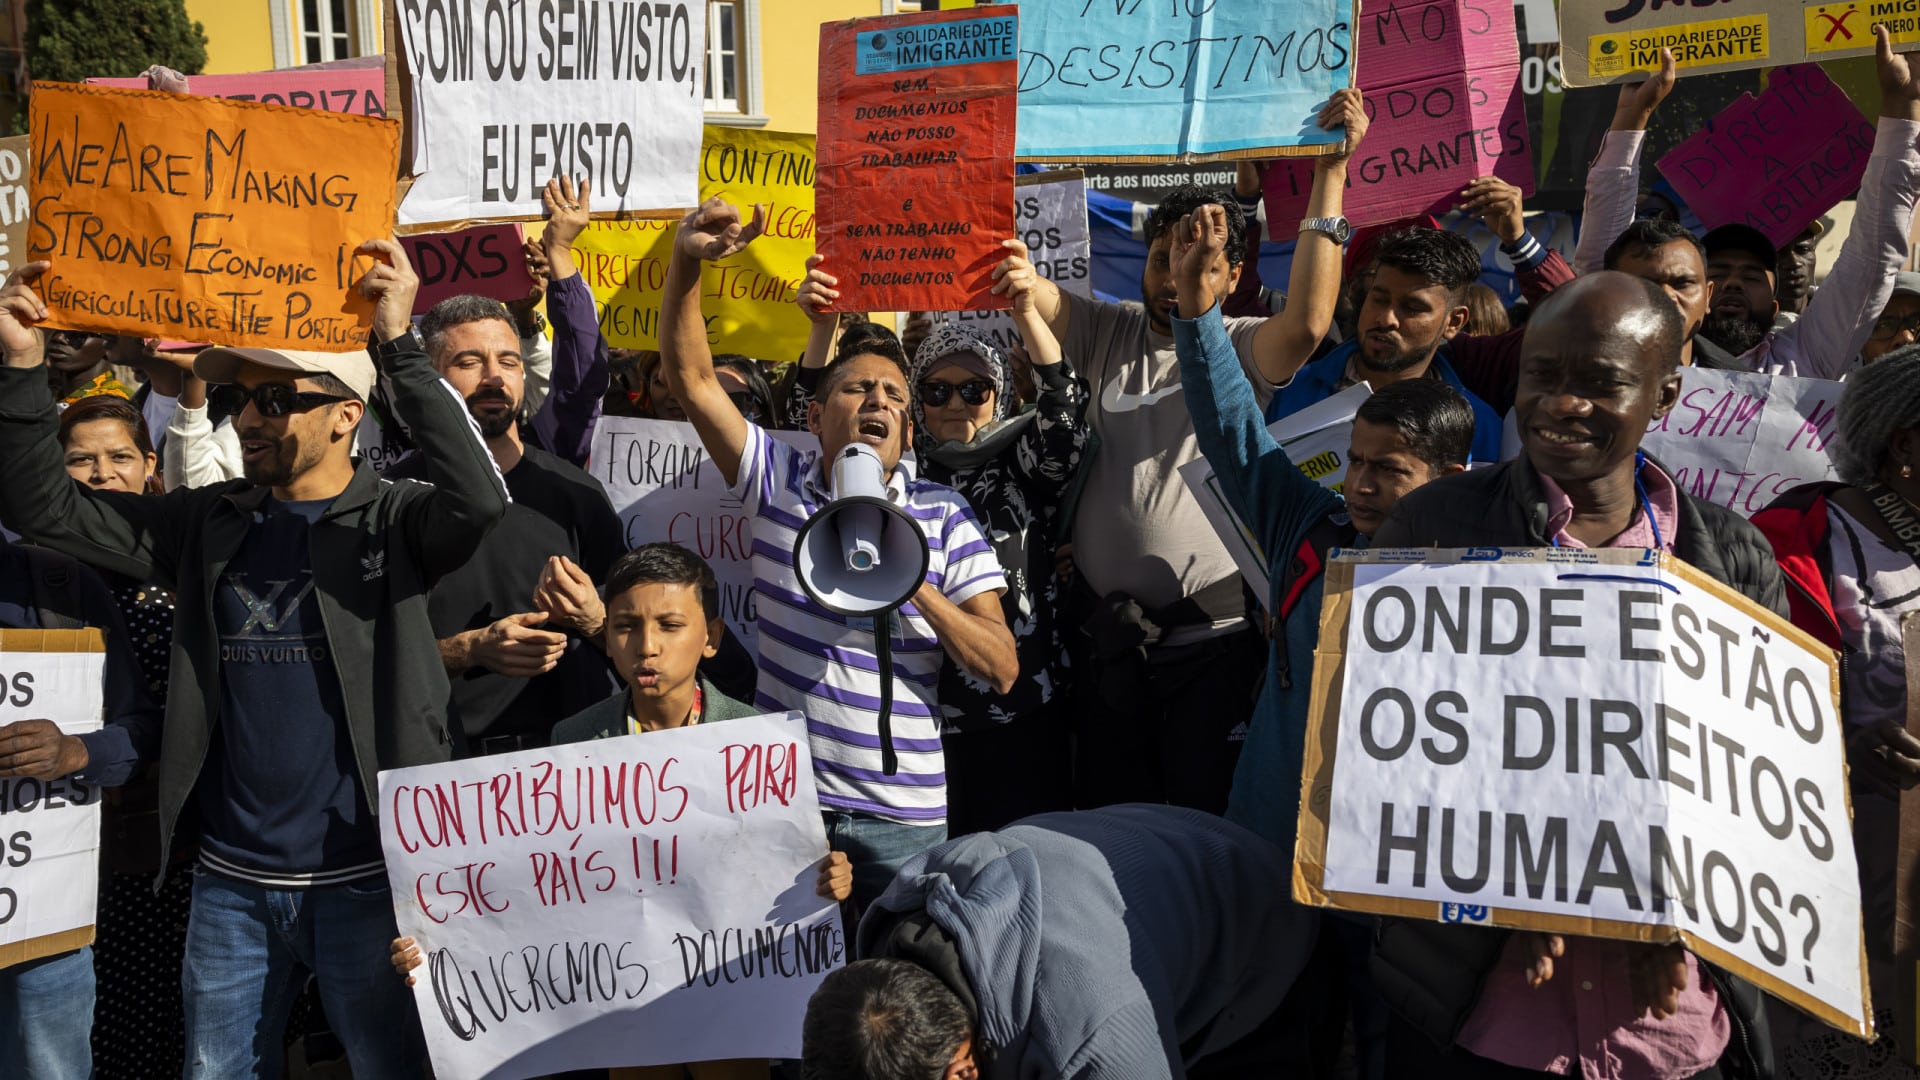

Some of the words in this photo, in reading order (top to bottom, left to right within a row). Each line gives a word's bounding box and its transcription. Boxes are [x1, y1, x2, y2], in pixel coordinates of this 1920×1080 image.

[1870, 0, 1920, 16] IMIG
[406, 0, 473, 83] COM
[484, 0, 528, 82] OU
[538, 0, 599, 81] SEM
[609, 2, 696, 98] VISTO,
[896, 20, 1013, 46] SOLIDARIEDADE
[896, 37, 1013, 65] IMIGRANTE
[1629, 24, 1763, 51] SOLIDARIEDADE
[1631, 37, 1762, 67] IMGRANTE
[1018, 22, 1349, 93] DESISTIMOS
[893, 78, 930, 93] SEM
[1362, 77, 1489, 124] DOS
[855, 100, 968, 121] DOCUMENTOS
[866, 127, 902, 144] NÃO
[905, 125, 956, 141] POSSO
[1287, 119, 1526, 196] IGRANTES
[483, 123, 520, 203] EU
[531, 121, 633, 201] EXISTO
[704, 143, 817, 189] CONTINU
[861, 150, 958, 168] TRABALHAR
[1114, 173, 1139, 189] aos
[1142, 172, 1190, 187] nossos
[1733, 119, 1877, 232] ABITAÇÃO
[31, 192, 172, 271] STRONG
[846, 223, 881, 238] SEM
[886, 221, 972, 238] TRABALHO
[1018, 227, 1062, 251] OS
[570, 247, 671, 293] IREITO
[859, 246, 895, 262] NÃO
[900, 246, 956, 261] TENHO
[217, 289, 273, 336] THE
[606, 431, 702, 490] FORAM
[1362, 585, 1586, 658] ONDE
[1619, 590, 1825, 745] ESTÃO
[0, 776, 90, 816] OES
[719, 742, 799, 813] PARA
[1360, 687, 1470, 765] OS
[1502, 694, 1835, 862] DIREITOS
[415, 861, 510, 924] ESTE
[1375, 802, 1822, 984] HUMANOS?
[427, 940, 649, 1042] QUEREMOS
[671, 917, 844, 990] DOCUMENTOS
